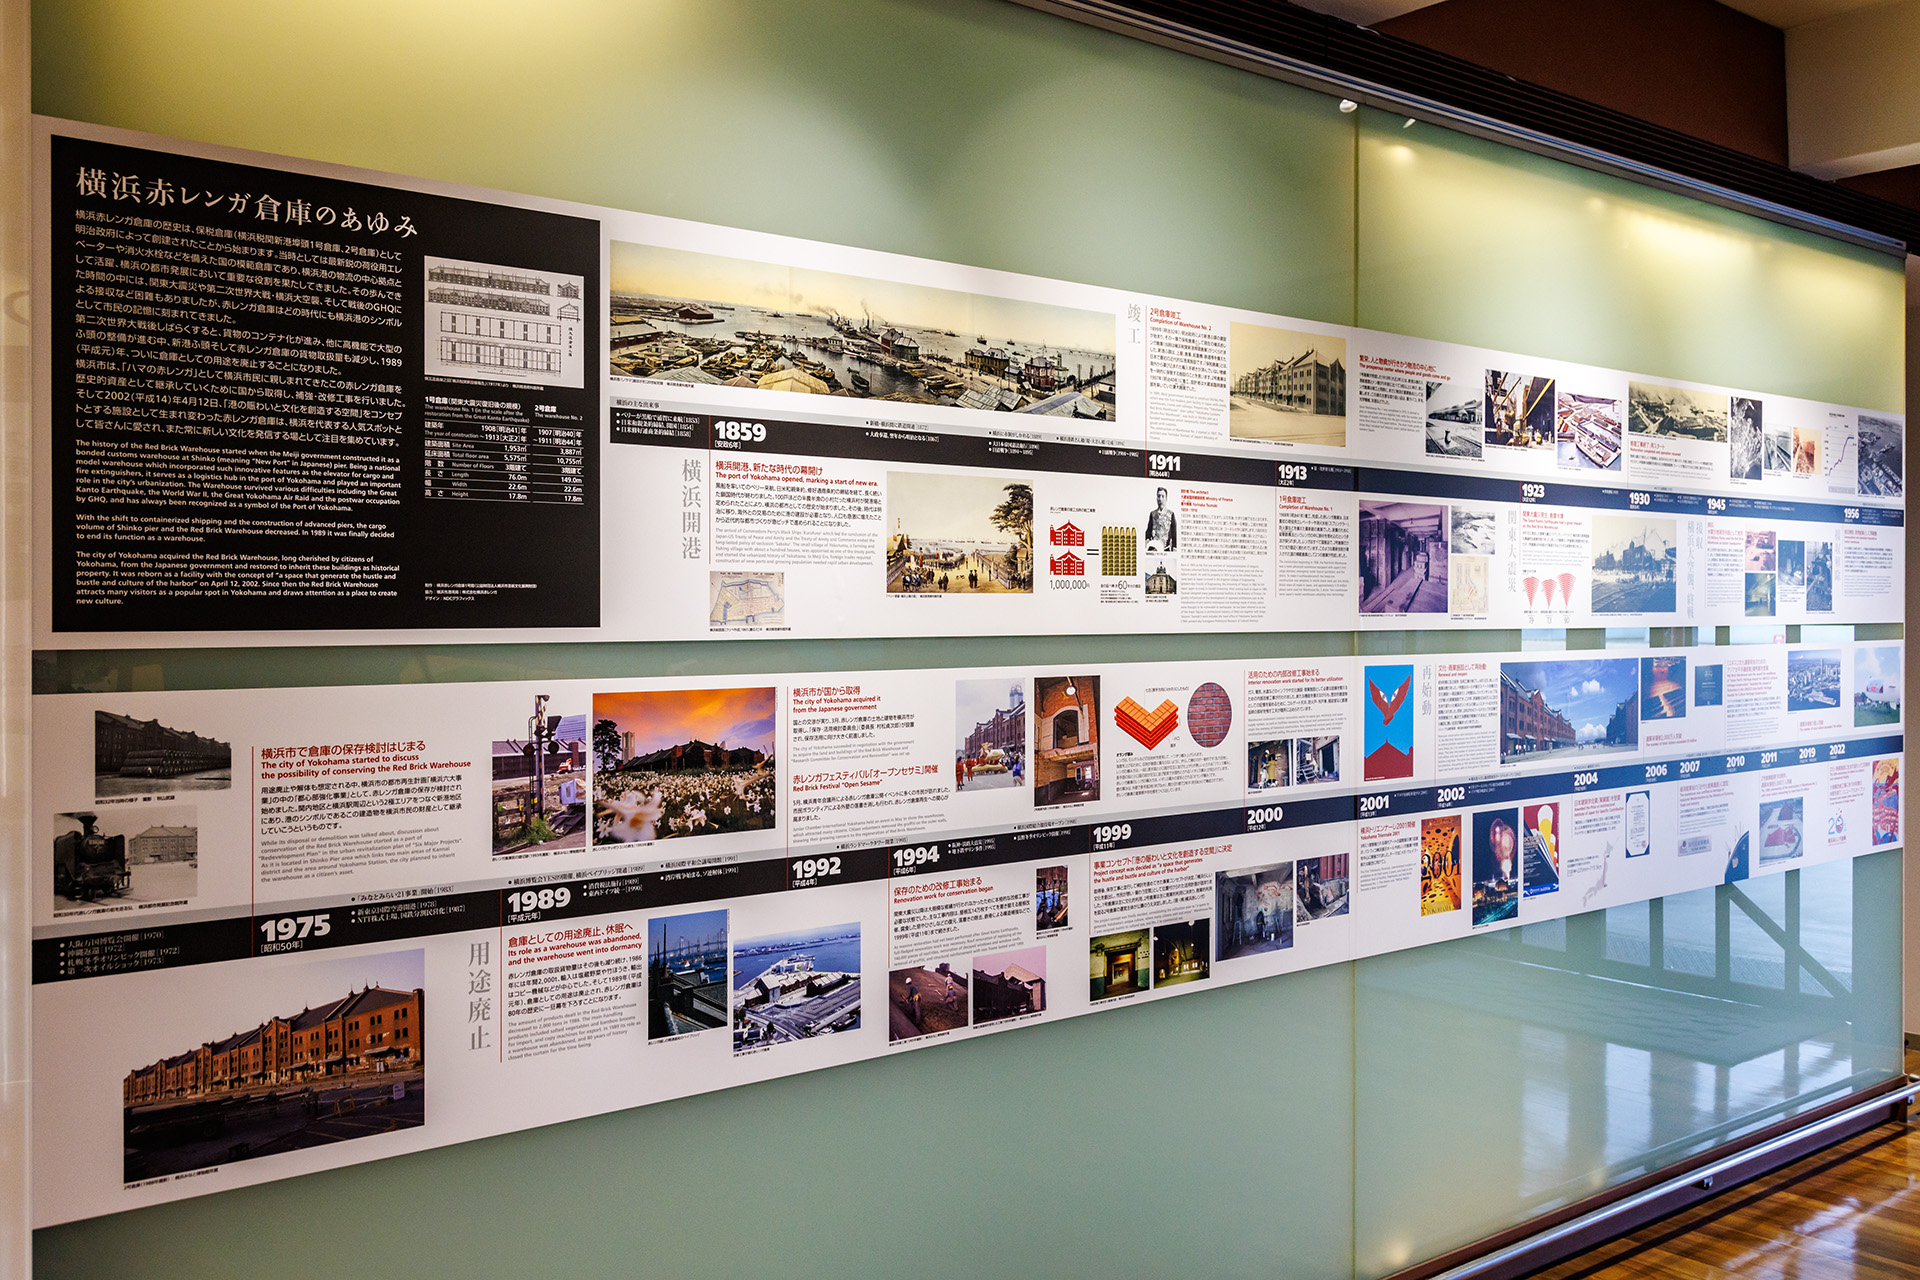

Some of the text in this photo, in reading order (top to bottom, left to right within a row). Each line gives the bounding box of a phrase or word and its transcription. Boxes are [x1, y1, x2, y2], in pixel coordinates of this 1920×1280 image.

[76, 166, 418, 238] 横浜赤レンガ倉庫のあゆみ
[1127, 303, 1141, 344] 竣工
[1149, 316, 1173, 325] Completion
[1178, 321, 1201, 329] Warehouse
[534, 404, 557, 413] 2号倉庫
[714, 420, 766, 442] 1859
[91, 439, 118, 449] history
[160, 443, 178, 451] Brick
[179, 445, 220, 454] Warehouse
[282, 450, 299, 459] Meiji
[300, 452, 341, 460] government
[715, 460, 823, 476] 横浜開港、新たな時代の幕開け
[1148, 453, 1180, 471] 1911
[508, 473, 527, 481] 76.0m
[741, 472, 749, 480] of
[749, 473, 780, 481] Yokohama
[805, 477, 829, 485] marking
[1278, 464, 1307, 480] 1913
[508, 492, 527, 500] 17.8m
[563, 485, 582, 493] 22.6m
[1521, 483, 1545, 498] 1923
[1629, 491, 1650, 505] 1930
[1706, 497, 1726, 511] 1945
[681, 458, 701, 559] 横浜開港
[1843, 507, 1859, 519] 1956
[792, 685, 860, 697] 横浜市が国から取得
[1421, 664, 1432, 716] 再始動
[804, 698, 815, 706] city
[852, 695, 876, 704] acquired
[843, 704, 877, 712] government
[260, 740, 426, 760] 横浜市で倉庫の保存検討はじまる
[1760, 751, 1777, 764] 2011
[1798, 746, 1816, 759] 2019
[1829, 743, 1846, 756] 2022
[260, 761, 277, 769] The
[278, 760, 294, 769] city
[295, 758, 305, 767] of
[307, 757, 350, 767] Yokohama
[351, 755, 380, 764] started
[391, 754, 419, 762] discuss
[1679, 760, 1700, 774] 2007
[1726, 755, 1745, 768] 2010
[260, 760, 471, 780] the possibility of conserving the Red Brick Warehouse
[792, 764, 938, 785] 赤レンガフェスティバル「オープンセサミ」開催
[1645, 763, 1668, 778] 2006
[819, 782, 840, 790] Festival
[1573, 771, 1598, 786] 2004
[1437, 786, 1465, 802] 2002
[1360, 794, 1389, 811] 2001
[1247, 806, 1283, 825] 2000
[1092, 823, 1132, 843] 1999
[893, 845, 940, 867] 1994
[792, 856, 841, 879] 1992
[507, 886, 571, 913] 1989
[893, 895, 923, 904] Renovation
[923, 892, 937, 900] work
[946, 888, 977, 897] conservation
[978, 885, 993, 893] began
[260, 913, 331, 942] 1975
[508, 922, 633, 948] 倉庫としての用途廃止、休眠へ
[507, 949, 517, 957] Its
[518, 947, 532, 955] role
[548, 941, 586, 951] warehouse
[587, 938, 602, 946] was
[603, 932, 641, 944] abandoned,
[507, 942, 642, 966] and the warehouse went into dormancy
[468, 941, 491, 1050] 用途廃止
